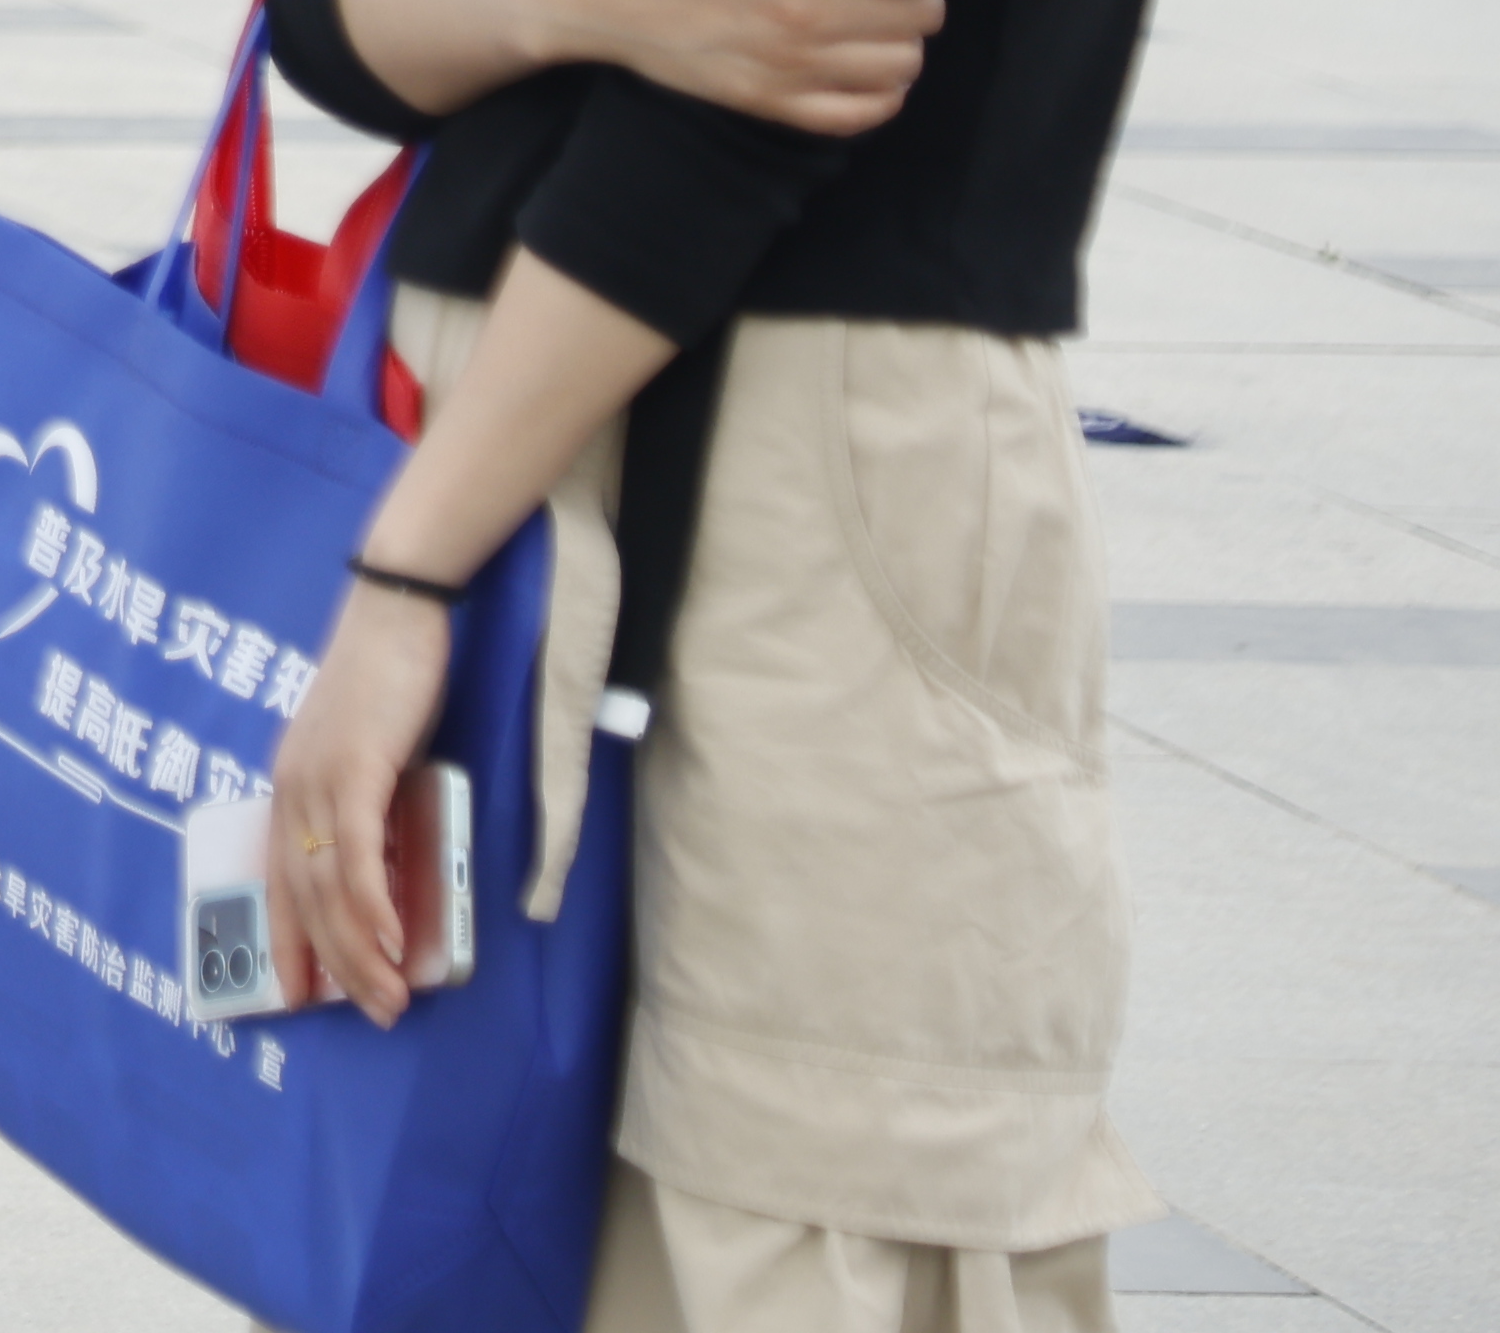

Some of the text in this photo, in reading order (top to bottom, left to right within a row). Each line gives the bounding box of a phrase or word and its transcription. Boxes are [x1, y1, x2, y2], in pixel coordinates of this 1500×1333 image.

[40, 653, 275, 808] 提高抵御灾
[257, 1039, 287, 1093] 宣
